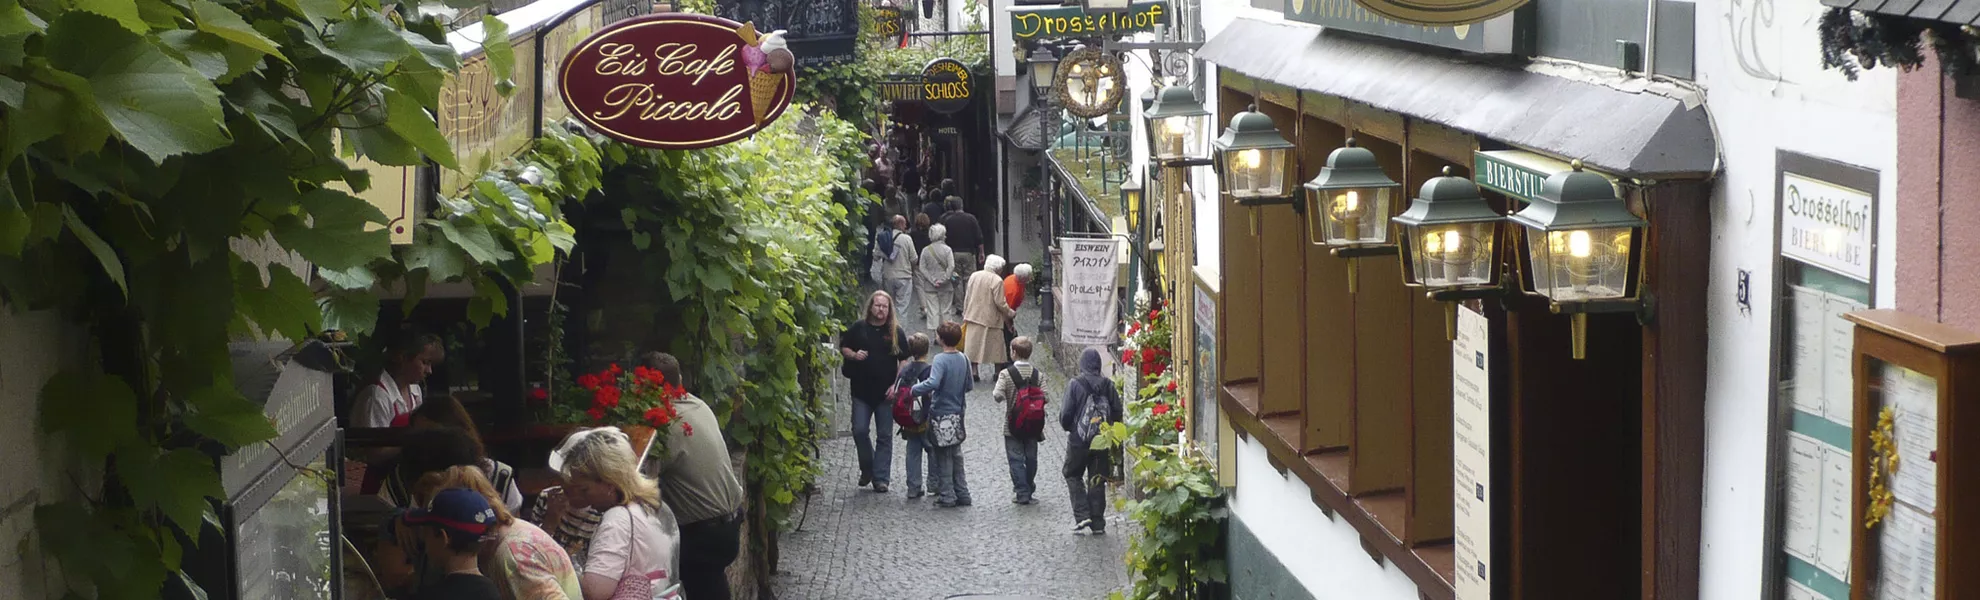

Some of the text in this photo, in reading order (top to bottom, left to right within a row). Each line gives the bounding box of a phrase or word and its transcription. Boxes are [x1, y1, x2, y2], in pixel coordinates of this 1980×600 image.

[1015, 4, 1163, 38] Drosselhof
[595, 43, 738, 86] Eis Cafe
[593, 82, 744, 121] Piccolo
[924, 81, 970, 100] SCHLOSS
[1787, 184, 1869, 240] Drosselhof
[1074, 244, 1110, 253] EISWEIN
